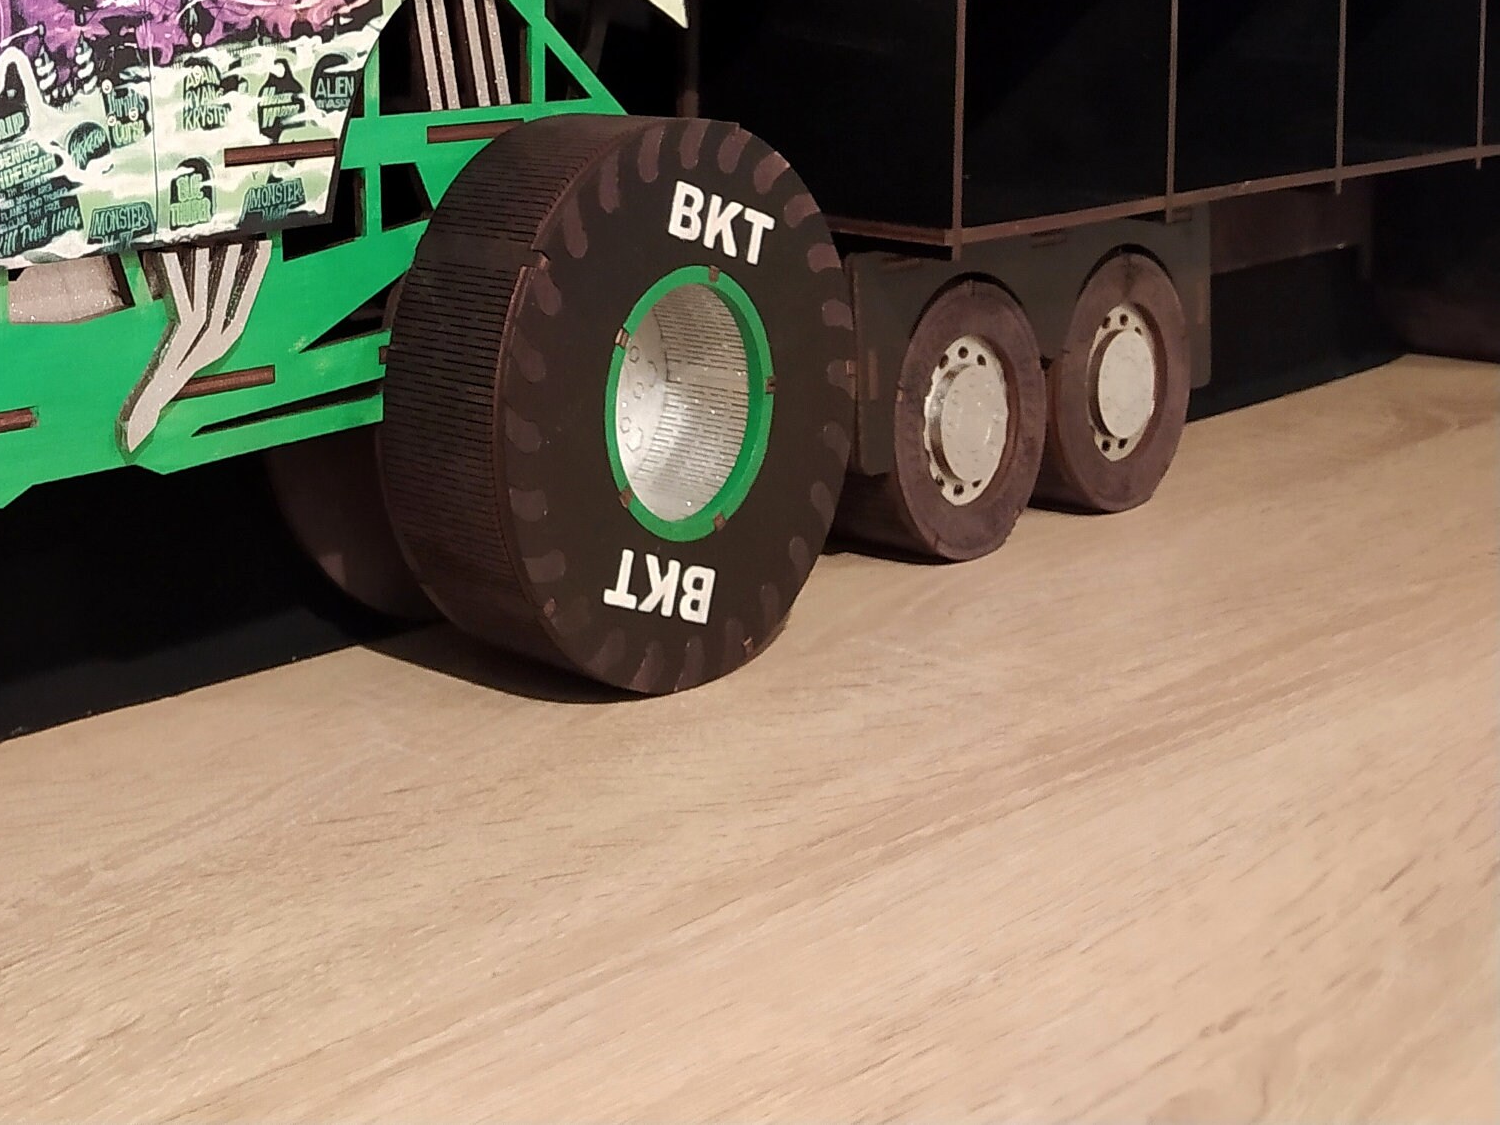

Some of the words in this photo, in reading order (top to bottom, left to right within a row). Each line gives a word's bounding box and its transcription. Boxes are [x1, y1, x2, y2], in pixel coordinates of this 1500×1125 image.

[314, 75, 355, 98] ALIEN
[248, 178, 303, 209] MONSTER
[51, 206, 81, 236] Hills
[92, 204, 148, 236] MONSTER
[667, 179, 776, 266] BKT
[603, 548, 717, 625] BKT
